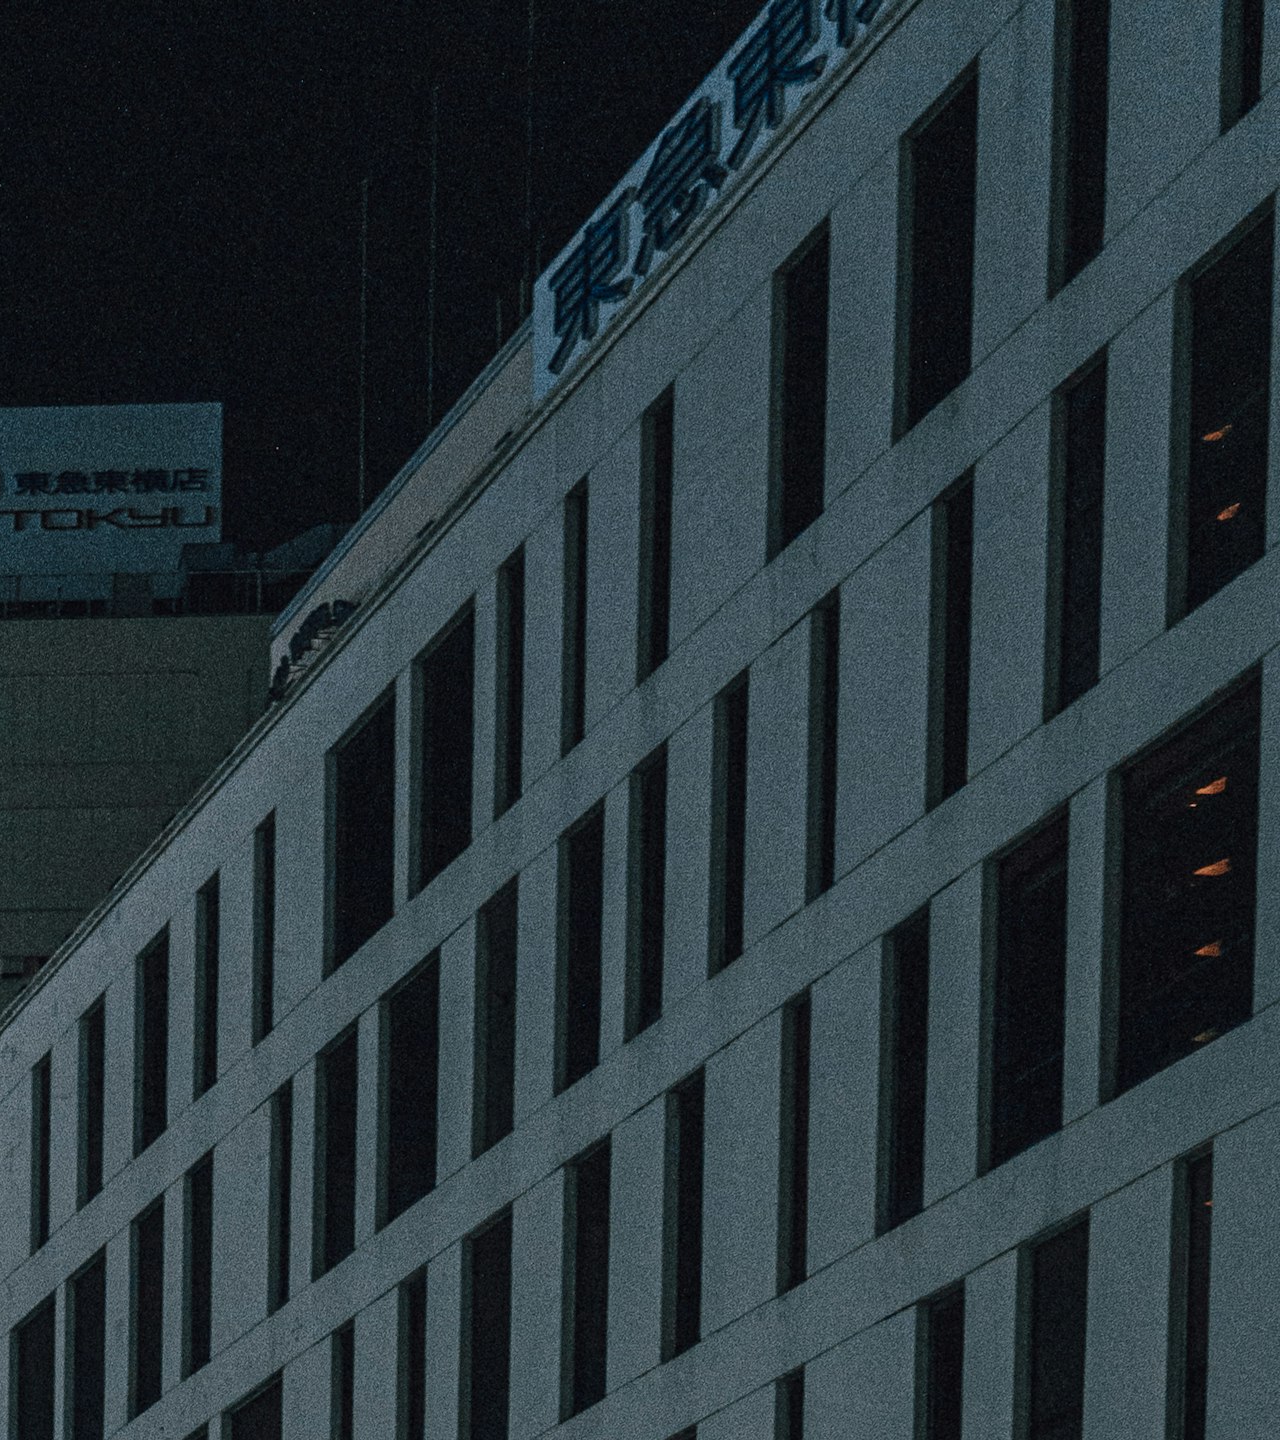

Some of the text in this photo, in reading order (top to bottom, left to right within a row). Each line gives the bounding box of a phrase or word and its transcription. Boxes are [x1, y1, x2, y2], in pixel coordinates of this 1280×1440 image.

[547, 0, 882, 374] 東急東
[14, 467, 209, 495] 東急東横店
